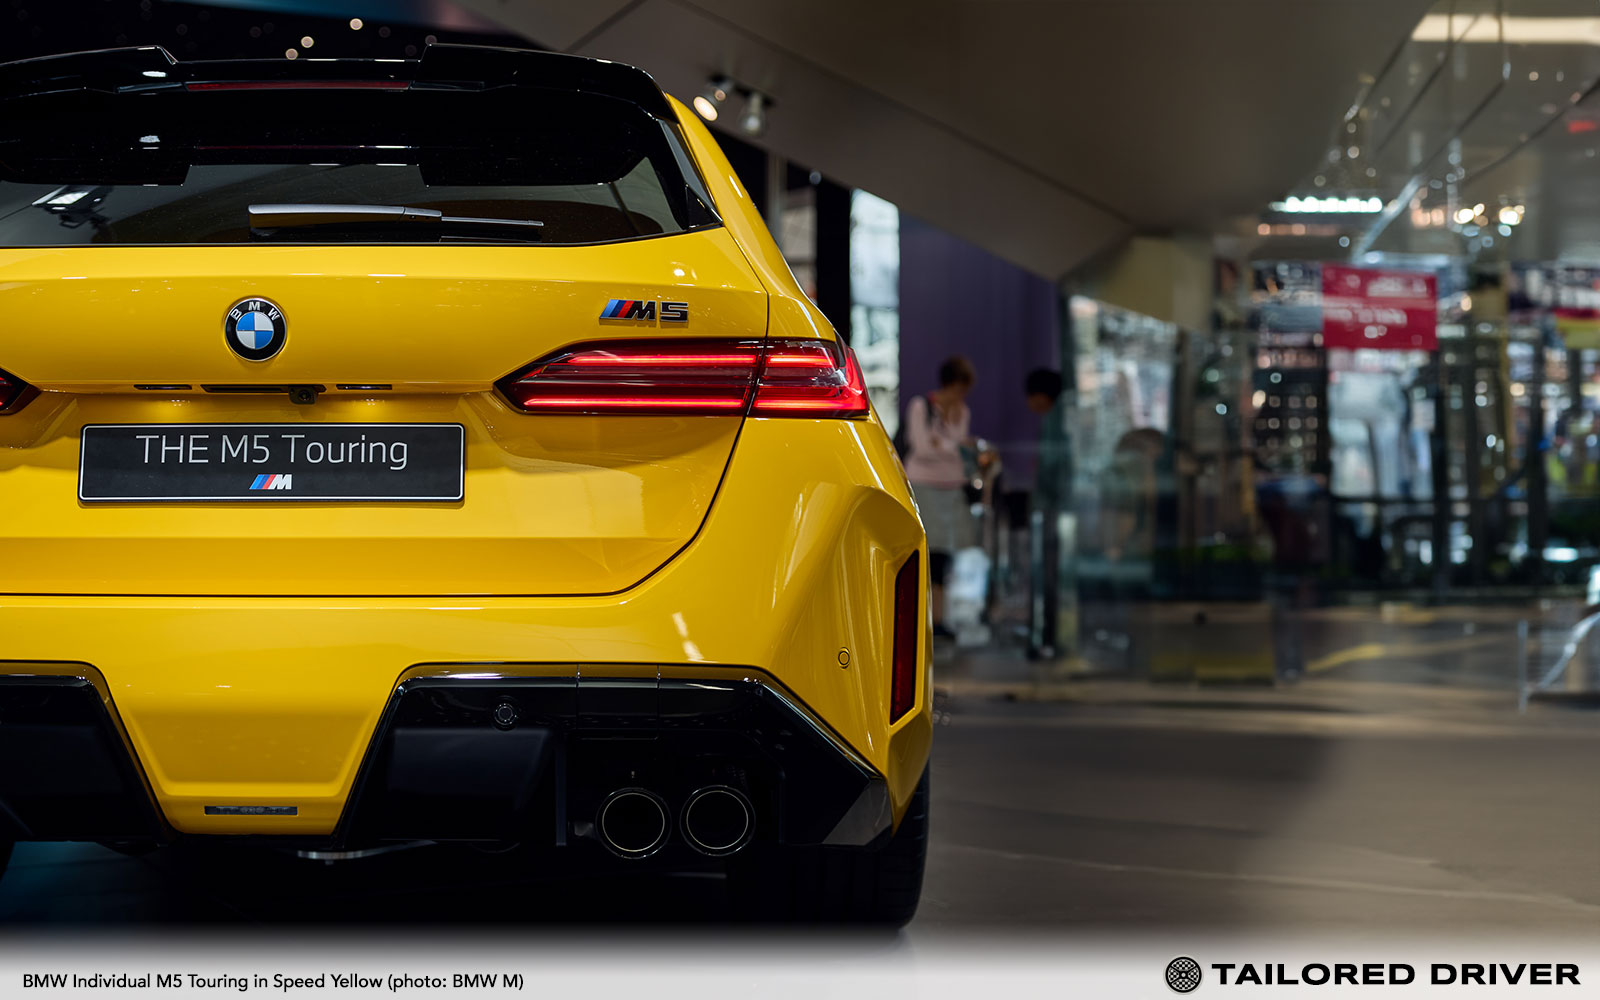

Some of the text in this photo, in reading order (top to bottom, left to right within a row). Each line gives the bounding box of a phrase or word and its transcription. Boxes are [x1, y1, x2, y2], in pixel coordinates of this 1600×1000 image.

[230, 301, 280, 321] BMW
[621, 299, 689, 322] M5
[136, 434, 408, 471] THE M5 Touring
